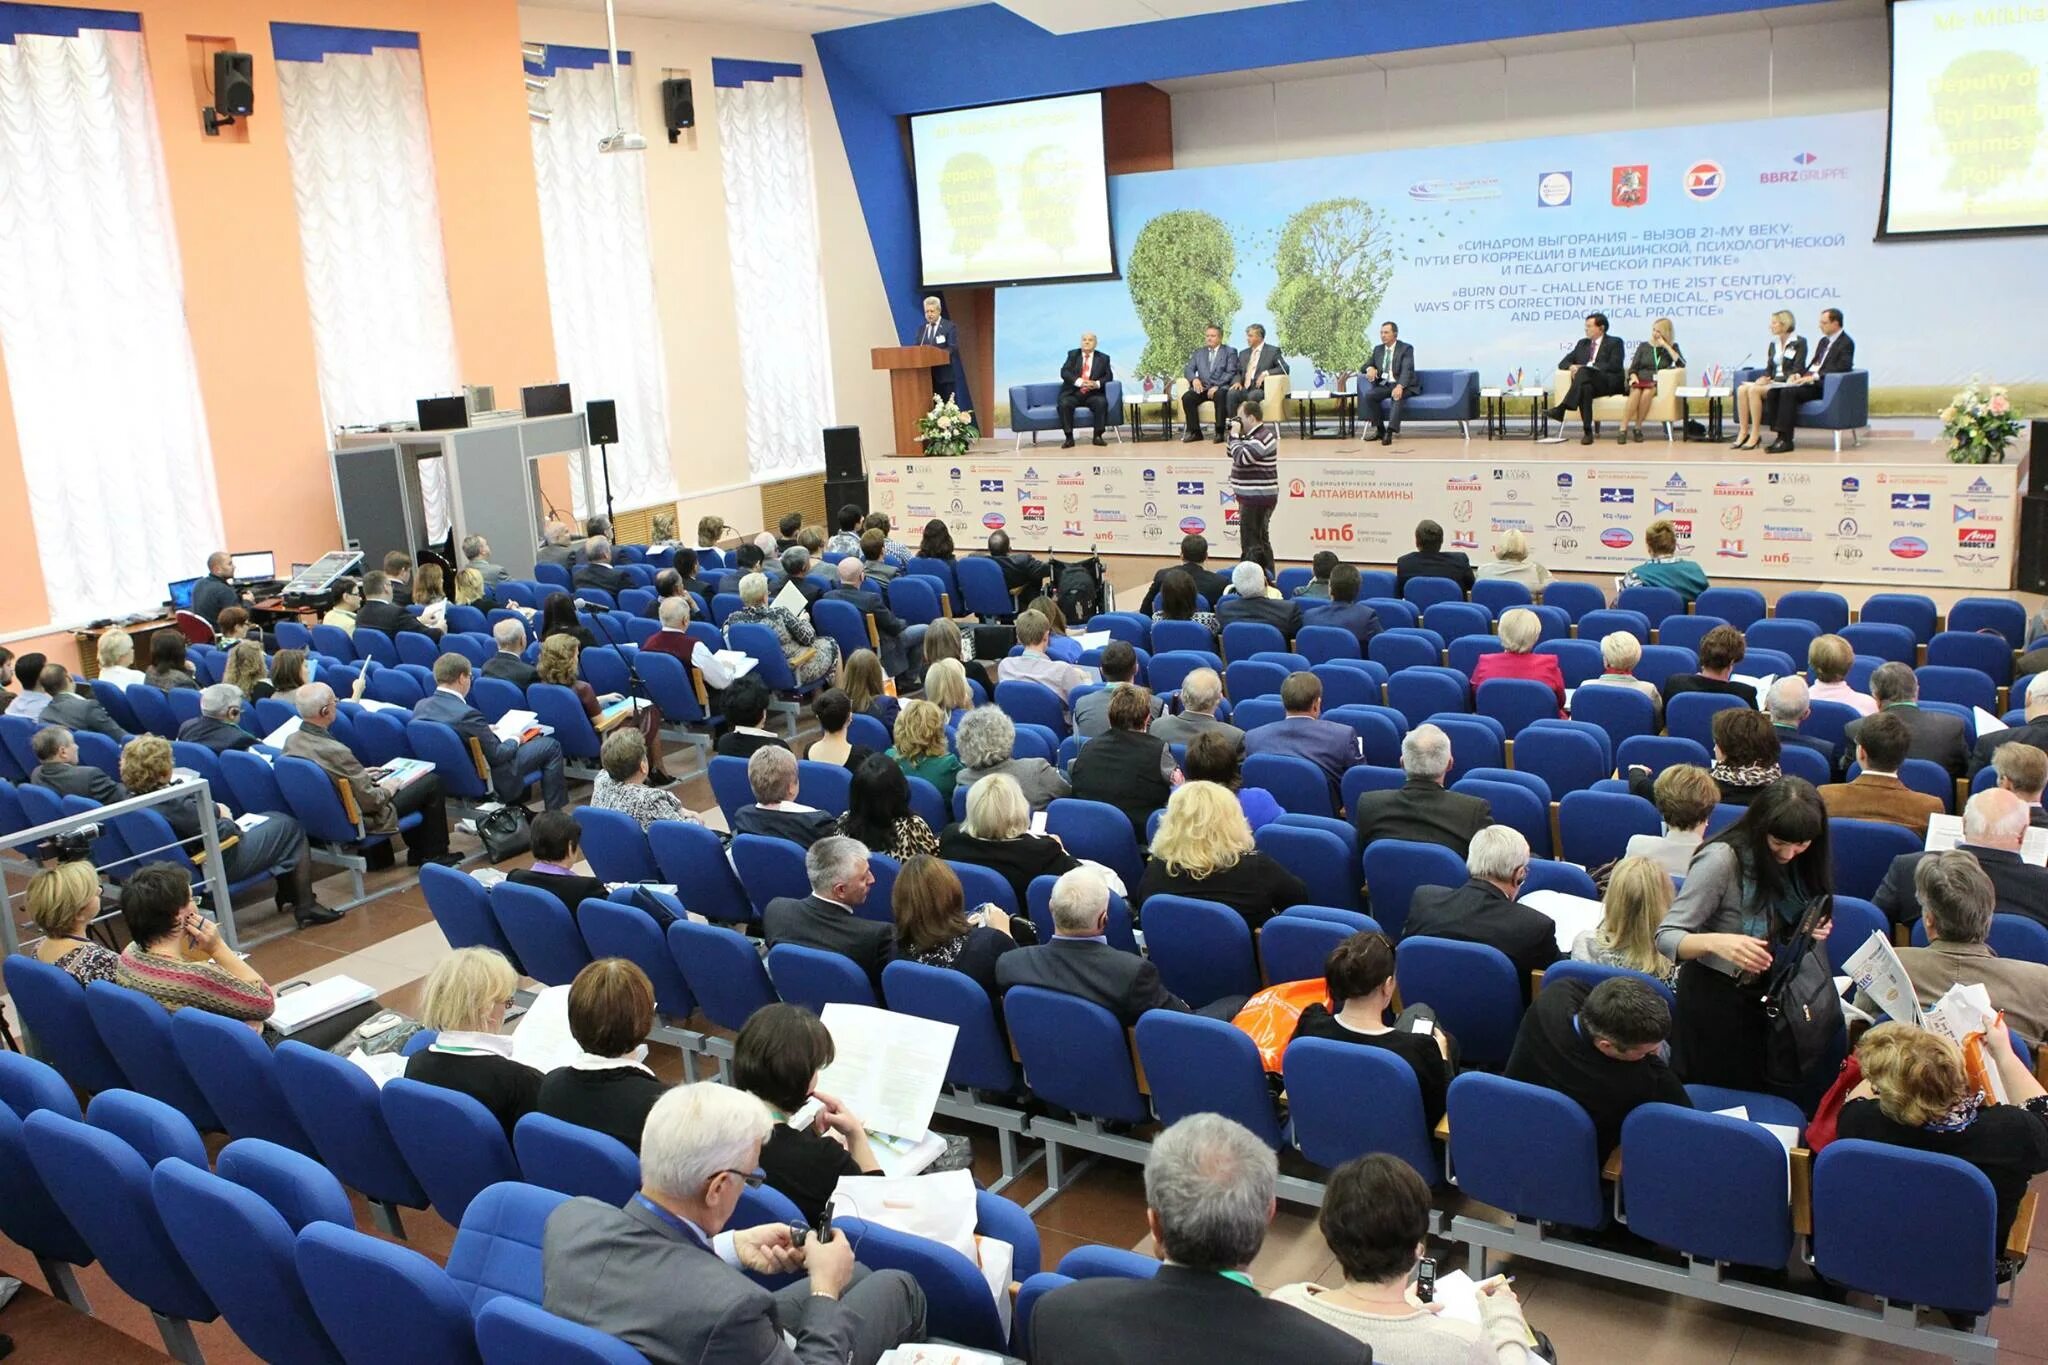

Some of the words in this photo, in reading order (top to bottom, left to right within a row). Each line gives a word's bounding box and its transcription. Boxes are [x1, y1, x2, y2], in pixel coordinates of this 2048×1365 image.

[1458, 237, 1534, 251] «СИНДРОМ
[1538, 231, 1627, 247] ВЫГОРАНИЯ
[1643, 227, 1696, 241] ВЫЗОВ
[1701, 225, 1744, 239] 21-МУ
[1749, 223, 1793, 236] ВЕКУ:
[1414, 255, 1450, 267] ПУТИ
[1453, 253, 1478, 265] ЕГО
[1481, 249, 1564, 264] КОРРЕКЦИИ
[1567, 248, 1577, 258] В
[1580, 241, 1692, 258] МЕДИЦИНСКОЙ,
[1696, 233, 1846, 252] ПСИХОЛОГИЧЕСКОЙ
[1501, 265, 1512, 276] И
[1515, 257, 1648, 275] ПЕДАГОГИЧЕСКОЙ
[1652, 254, 1740, 268] ПРАКТИКЕ»
[1499, 284, 1527, 296] OUT
[1542, 280, 1624, 294] CHALLENGE
[1629, 279, 1648, 290] TO
[1652, 277, 1681, 289] THE
[1685, 276, 1717, 288] 21ST
[1721, 273, 1796, 287] CENTURY:
[1414, 301, 1450, 313] WAYS
[1453, 300, 1471, 311] OF
[1474, 299, 1495, 310] ITS
[1498, 294, 1587, 309] CORRECTION
[1590, 294, 1604, 305] IN
[1607, 293, 1636, 305] THE
[1640, 291, 1709, 305] MEDICAL,
[1713, 287, 1841, 301] PSYCHOLOGICAL
[1511, 311, 1541, 322] AND
[1645, 304, 1724, 318] PRACTICE»
